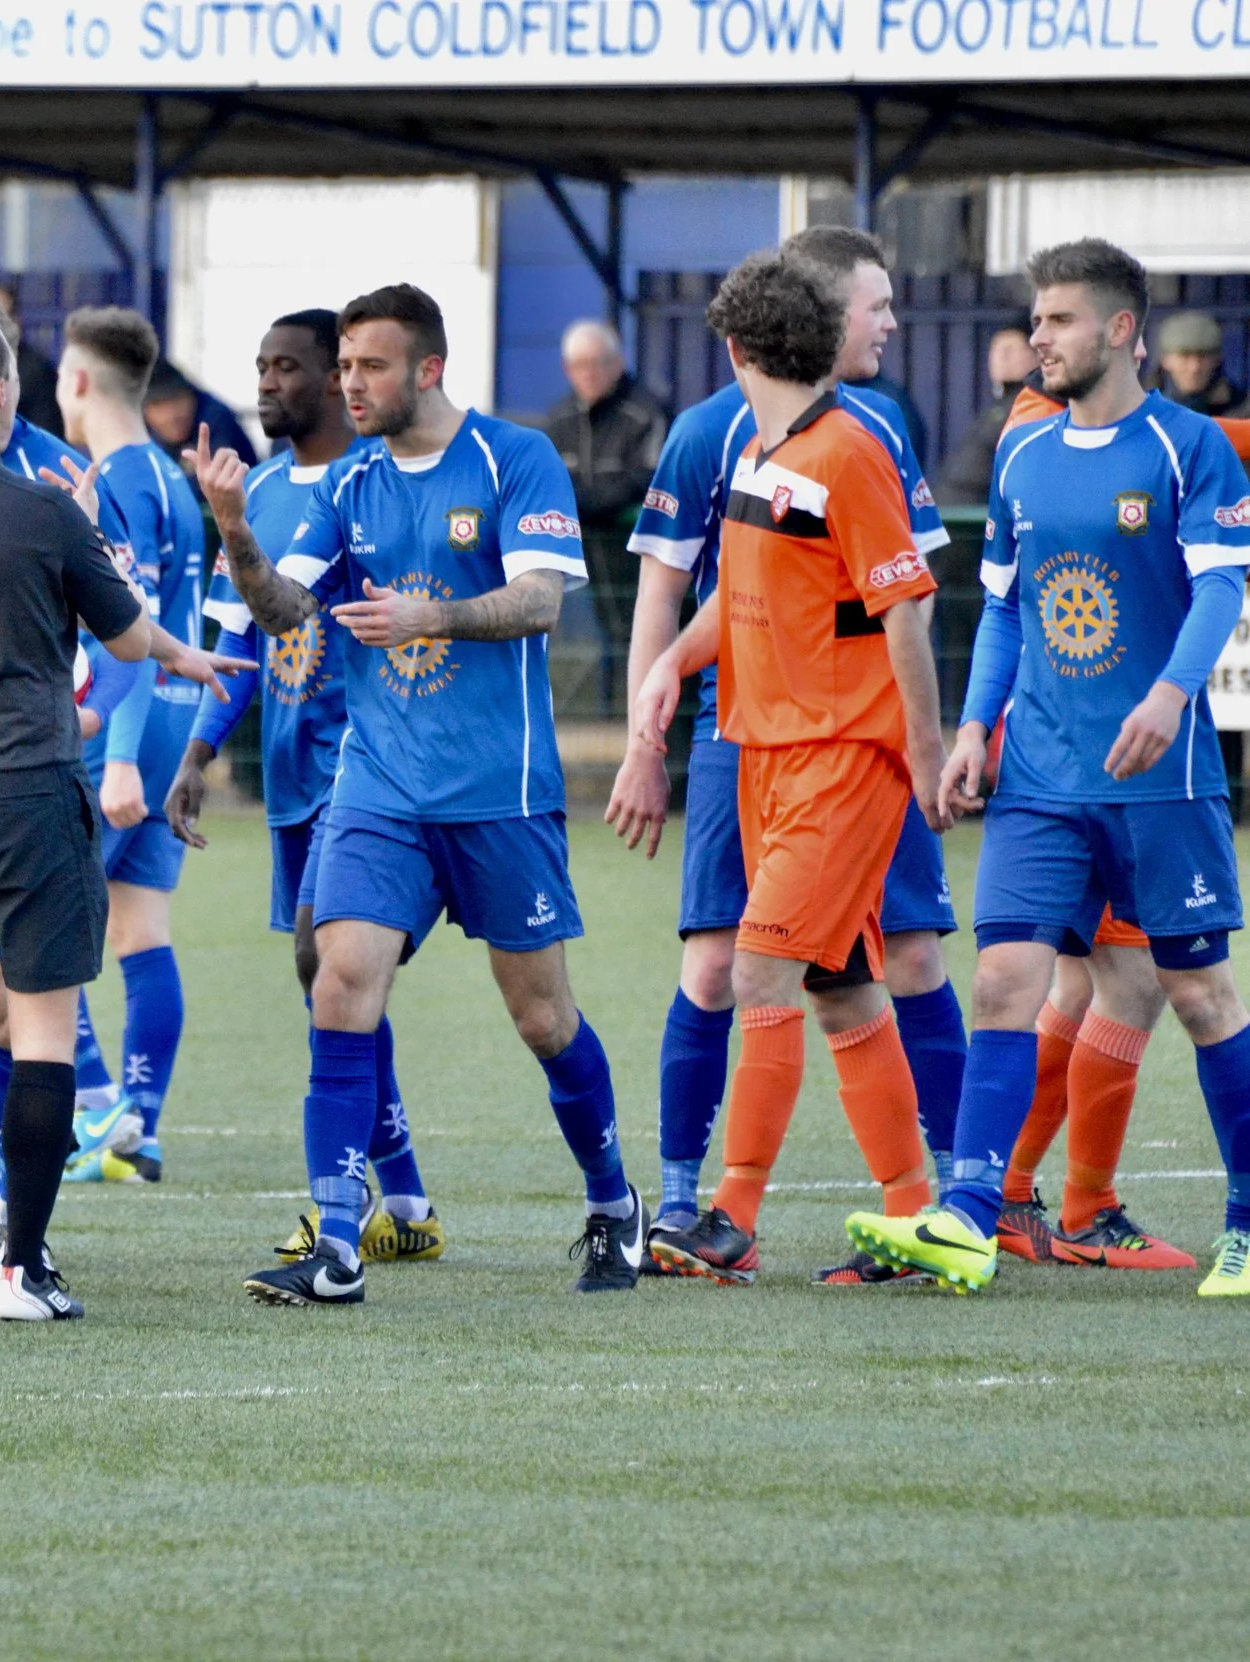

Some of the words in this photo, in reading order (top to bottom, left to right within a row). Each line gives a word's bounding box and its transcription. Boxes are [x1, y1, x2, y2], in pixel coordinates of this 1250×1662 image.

[63, 8, 112, 60] to
[138, 0, 341, 61] SUTTON
[367, 0, 662, 60] COLDFIELD
[690, 0, 845, 58] TOWN
[876, 0, 1159, 55] FOOTBALL
[742, 920, 789, 937] macron
